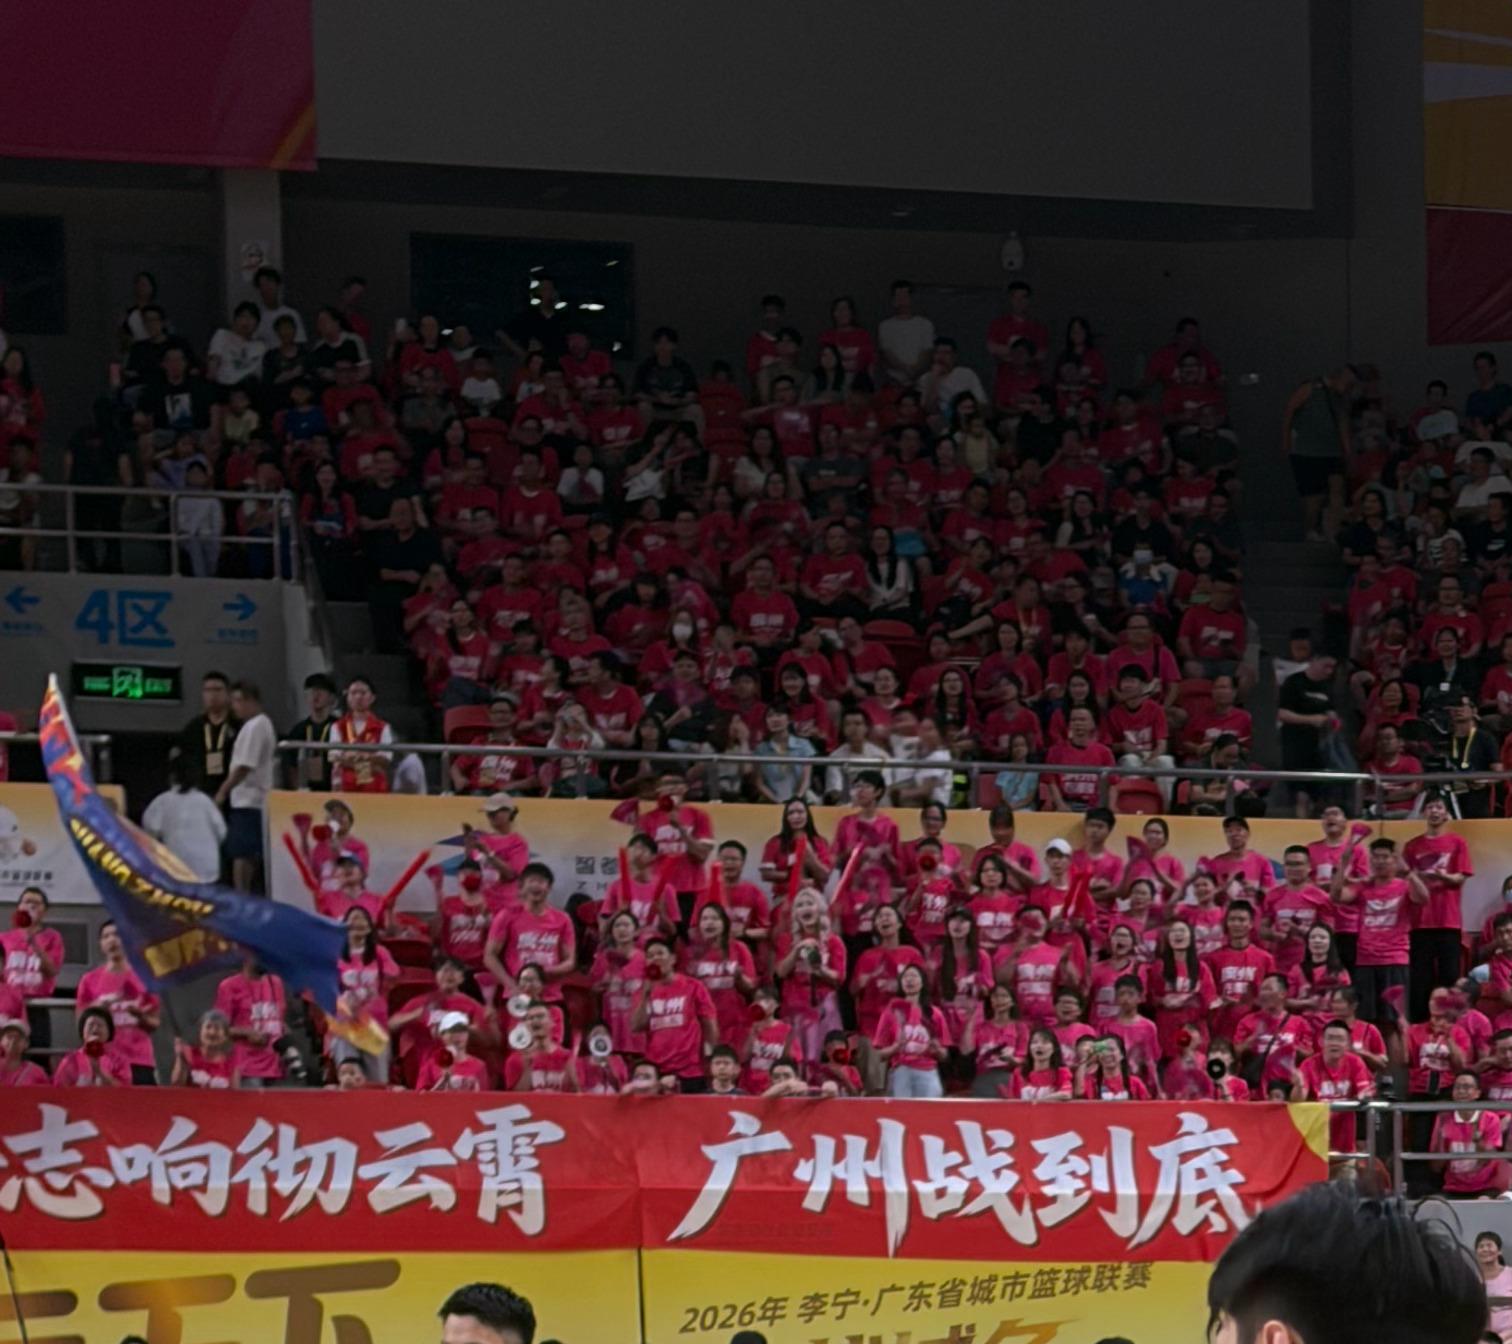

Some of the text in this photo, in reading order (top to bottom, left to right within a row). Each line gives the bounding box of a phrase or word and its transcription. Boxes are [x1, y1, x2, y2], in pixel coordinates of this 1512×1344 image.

[75, 589, 175, 648] 4区
[2, 1102, 566, 1237] 志响彻云霄
[667, 1110, 1260, 1259] 广州战到底
[679, 1297, 789, 1335] 2026年
